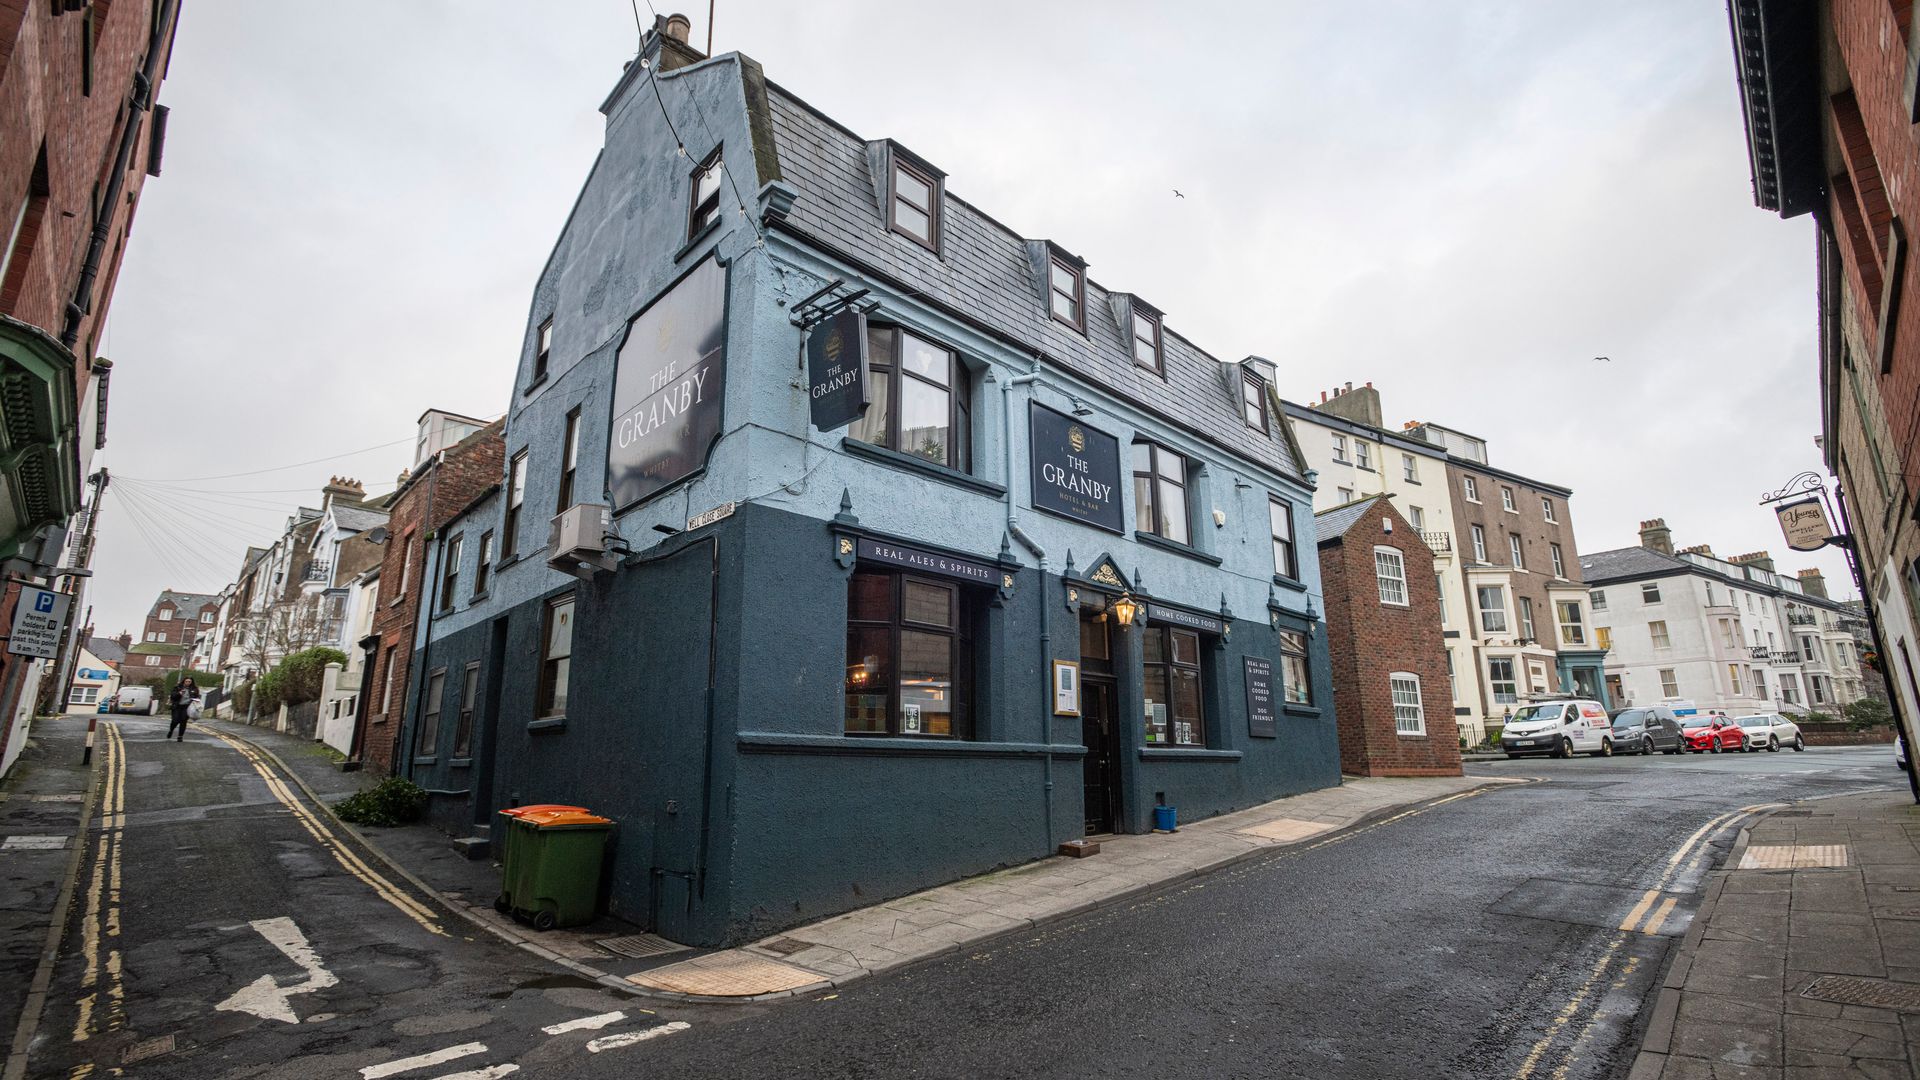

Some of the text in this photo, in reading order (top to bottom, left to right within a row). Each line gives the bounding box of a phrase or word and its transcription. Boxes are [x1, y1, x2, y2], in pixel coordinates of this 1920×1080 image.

[650, 360, 677, 394] THE
[827, 364, 842, 377] THE
[812, 367, 858, 399] GRANBY
[619, 366, 710, 449] GRANBY
[1067, 454, 1089, 474] THE
[1042, 463, 1112, 503] GRANBY
[1059, 492, 1080, 505] HOTEL
[1087, 502, 1100, 511] BAR
[689, 502, 732, 529] WELL CLOSE SQUARE
[875, 547, 989, 578] REAL ALES & SPIRITS
[25, 612, 47, 622] Permit
[1156, 609, 1217, 629] HOME COOKED FOOD
[22, 621, 46, 630] holders
[17, 628, 56, 641] parking only
[12, 635, 57, 648] past this point
[1247, 660, 1258, 668] REAL
[1253, 668, 1270, 676] SPIRITS
[1253, 680, 1266, 688] HOME
[1251, 687, 1270, 695] COOKED
[1252, 714, 1274, 722] FRIENDLY
